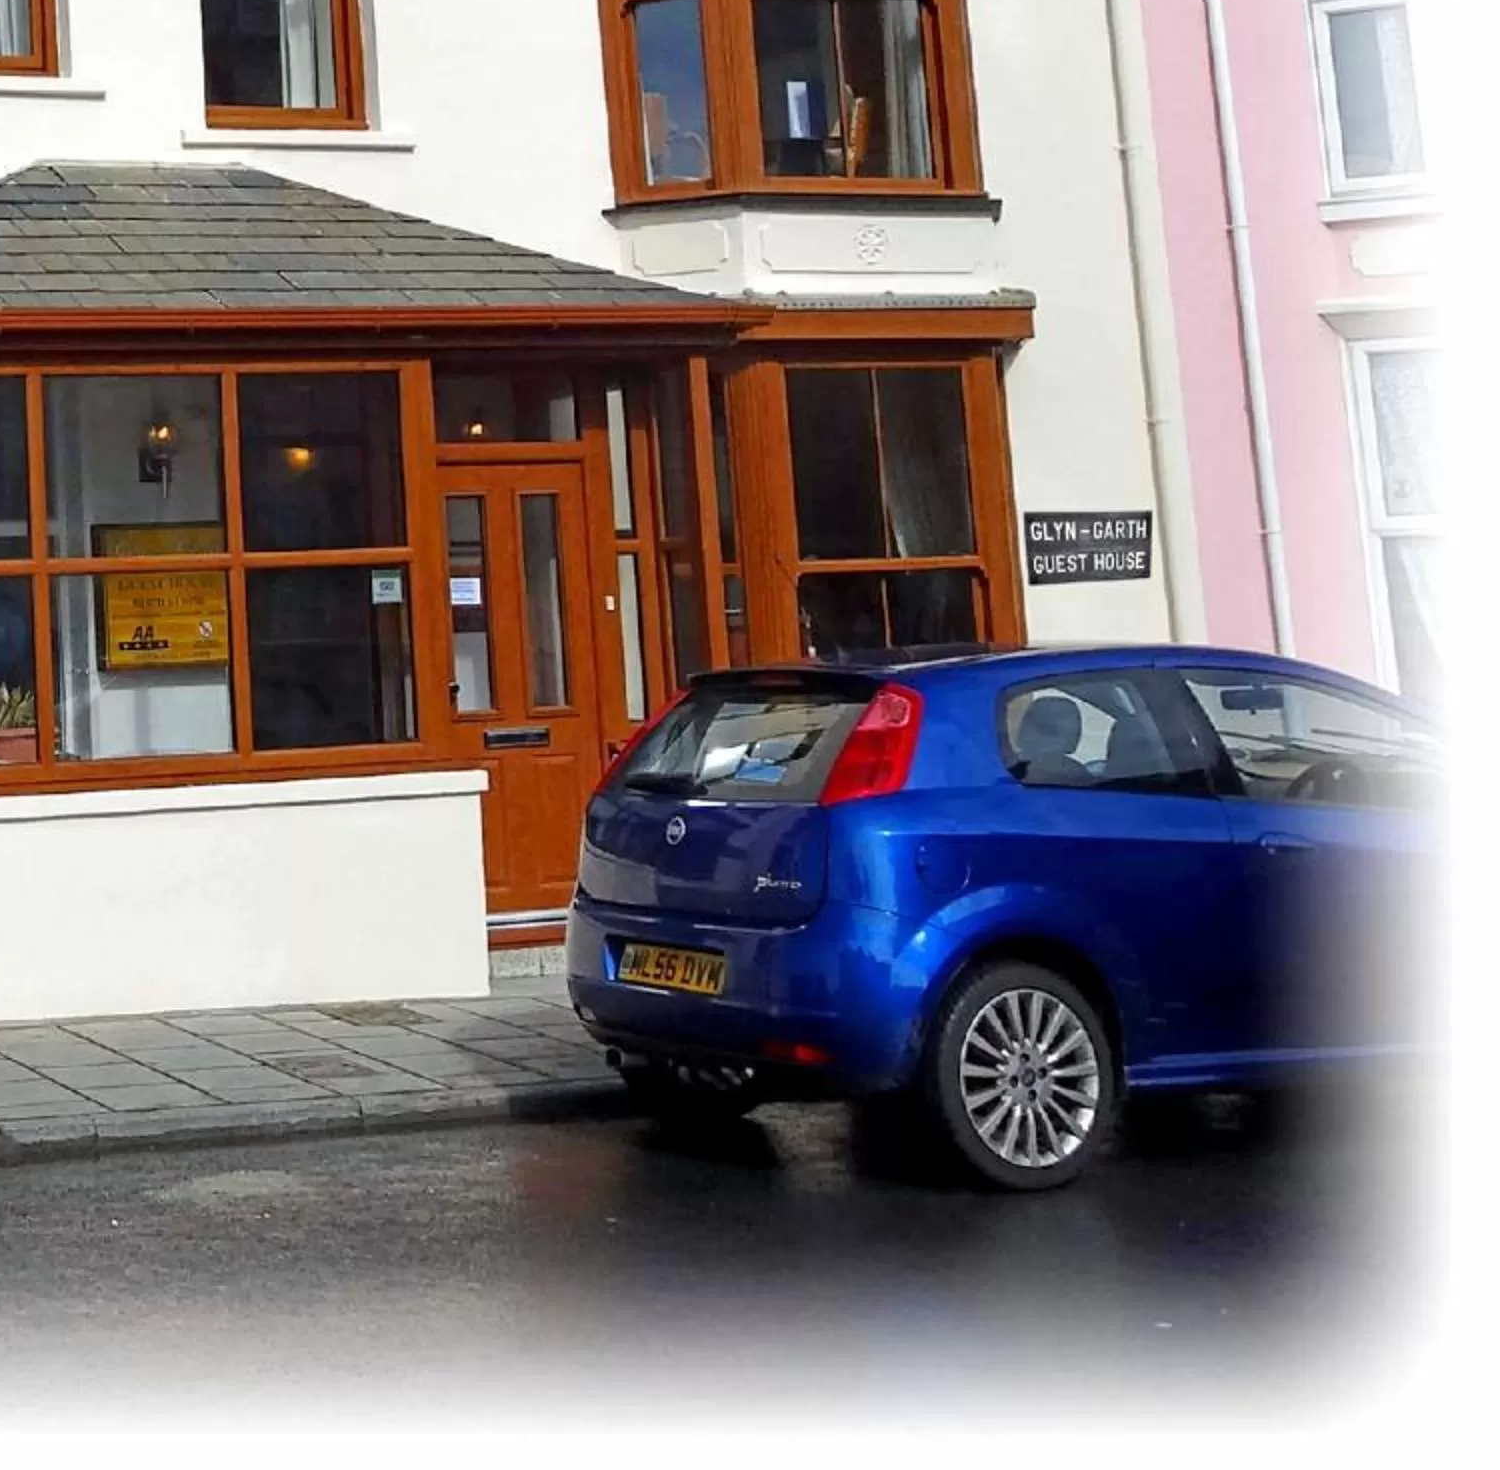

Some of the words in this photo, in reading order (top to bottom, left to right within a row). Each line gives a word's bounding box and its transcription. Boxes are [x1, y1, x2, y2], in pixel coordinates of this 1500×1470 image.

[1032, 552, 1089, 575] GUEST
[1093, 551, 1147, 571] HOUSE
[131, 625, 156, 640] AA
